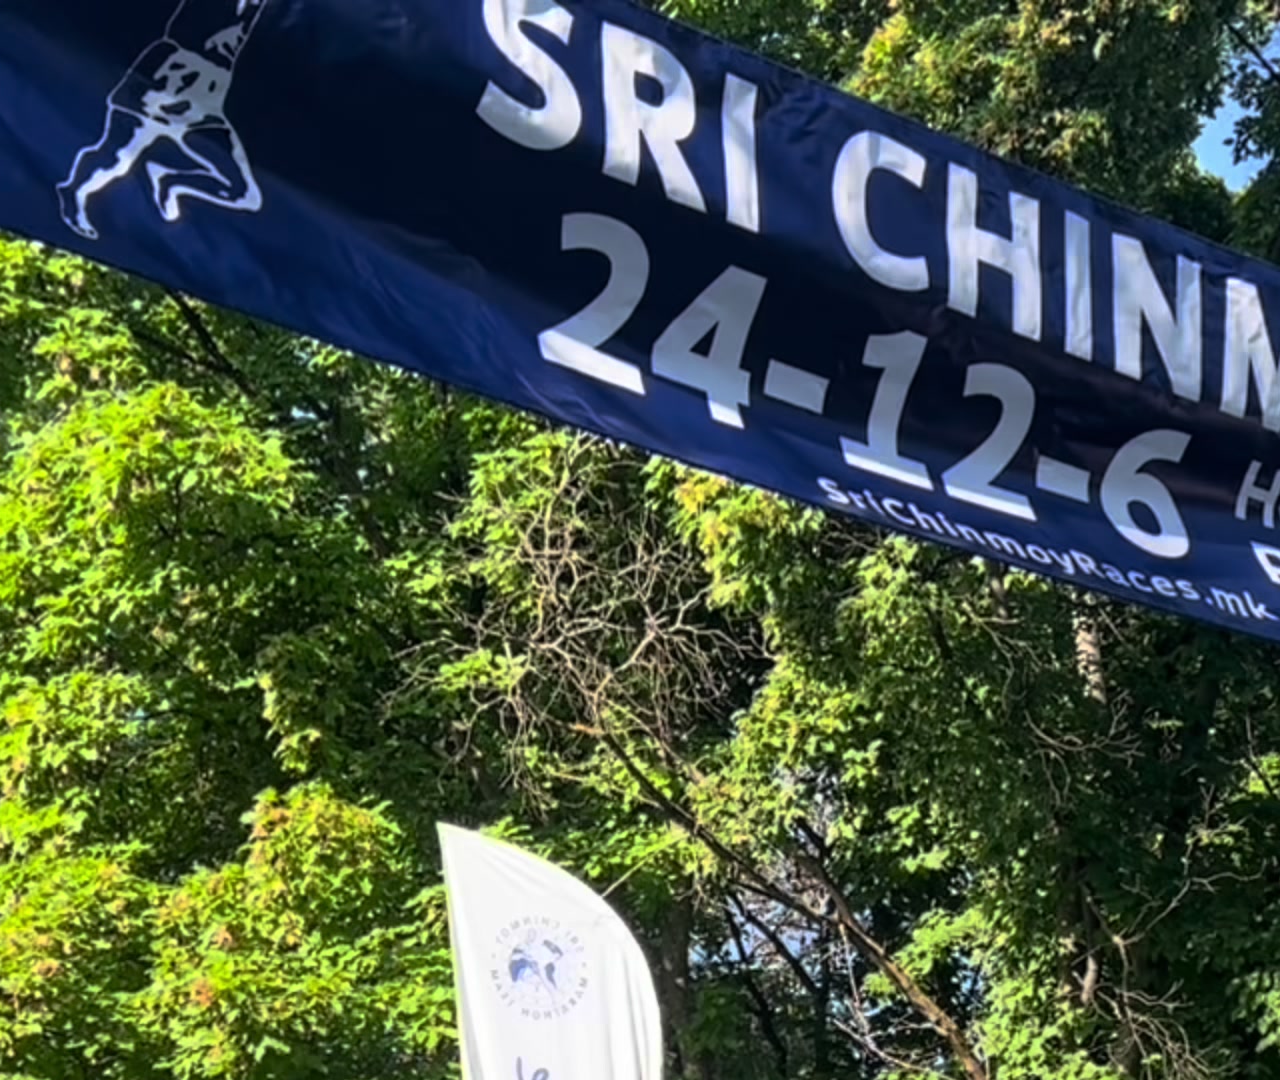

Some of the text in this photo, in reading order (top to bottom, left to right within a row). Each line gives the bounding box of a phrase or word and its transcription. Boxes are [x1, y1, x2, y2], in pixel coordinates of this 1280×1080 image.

[476, 0, 760, 233] SRI
[539, 211, 1193, 561] 24-12-6
[817, 475, 1278, 623] SriChinmoyRaces.mk
